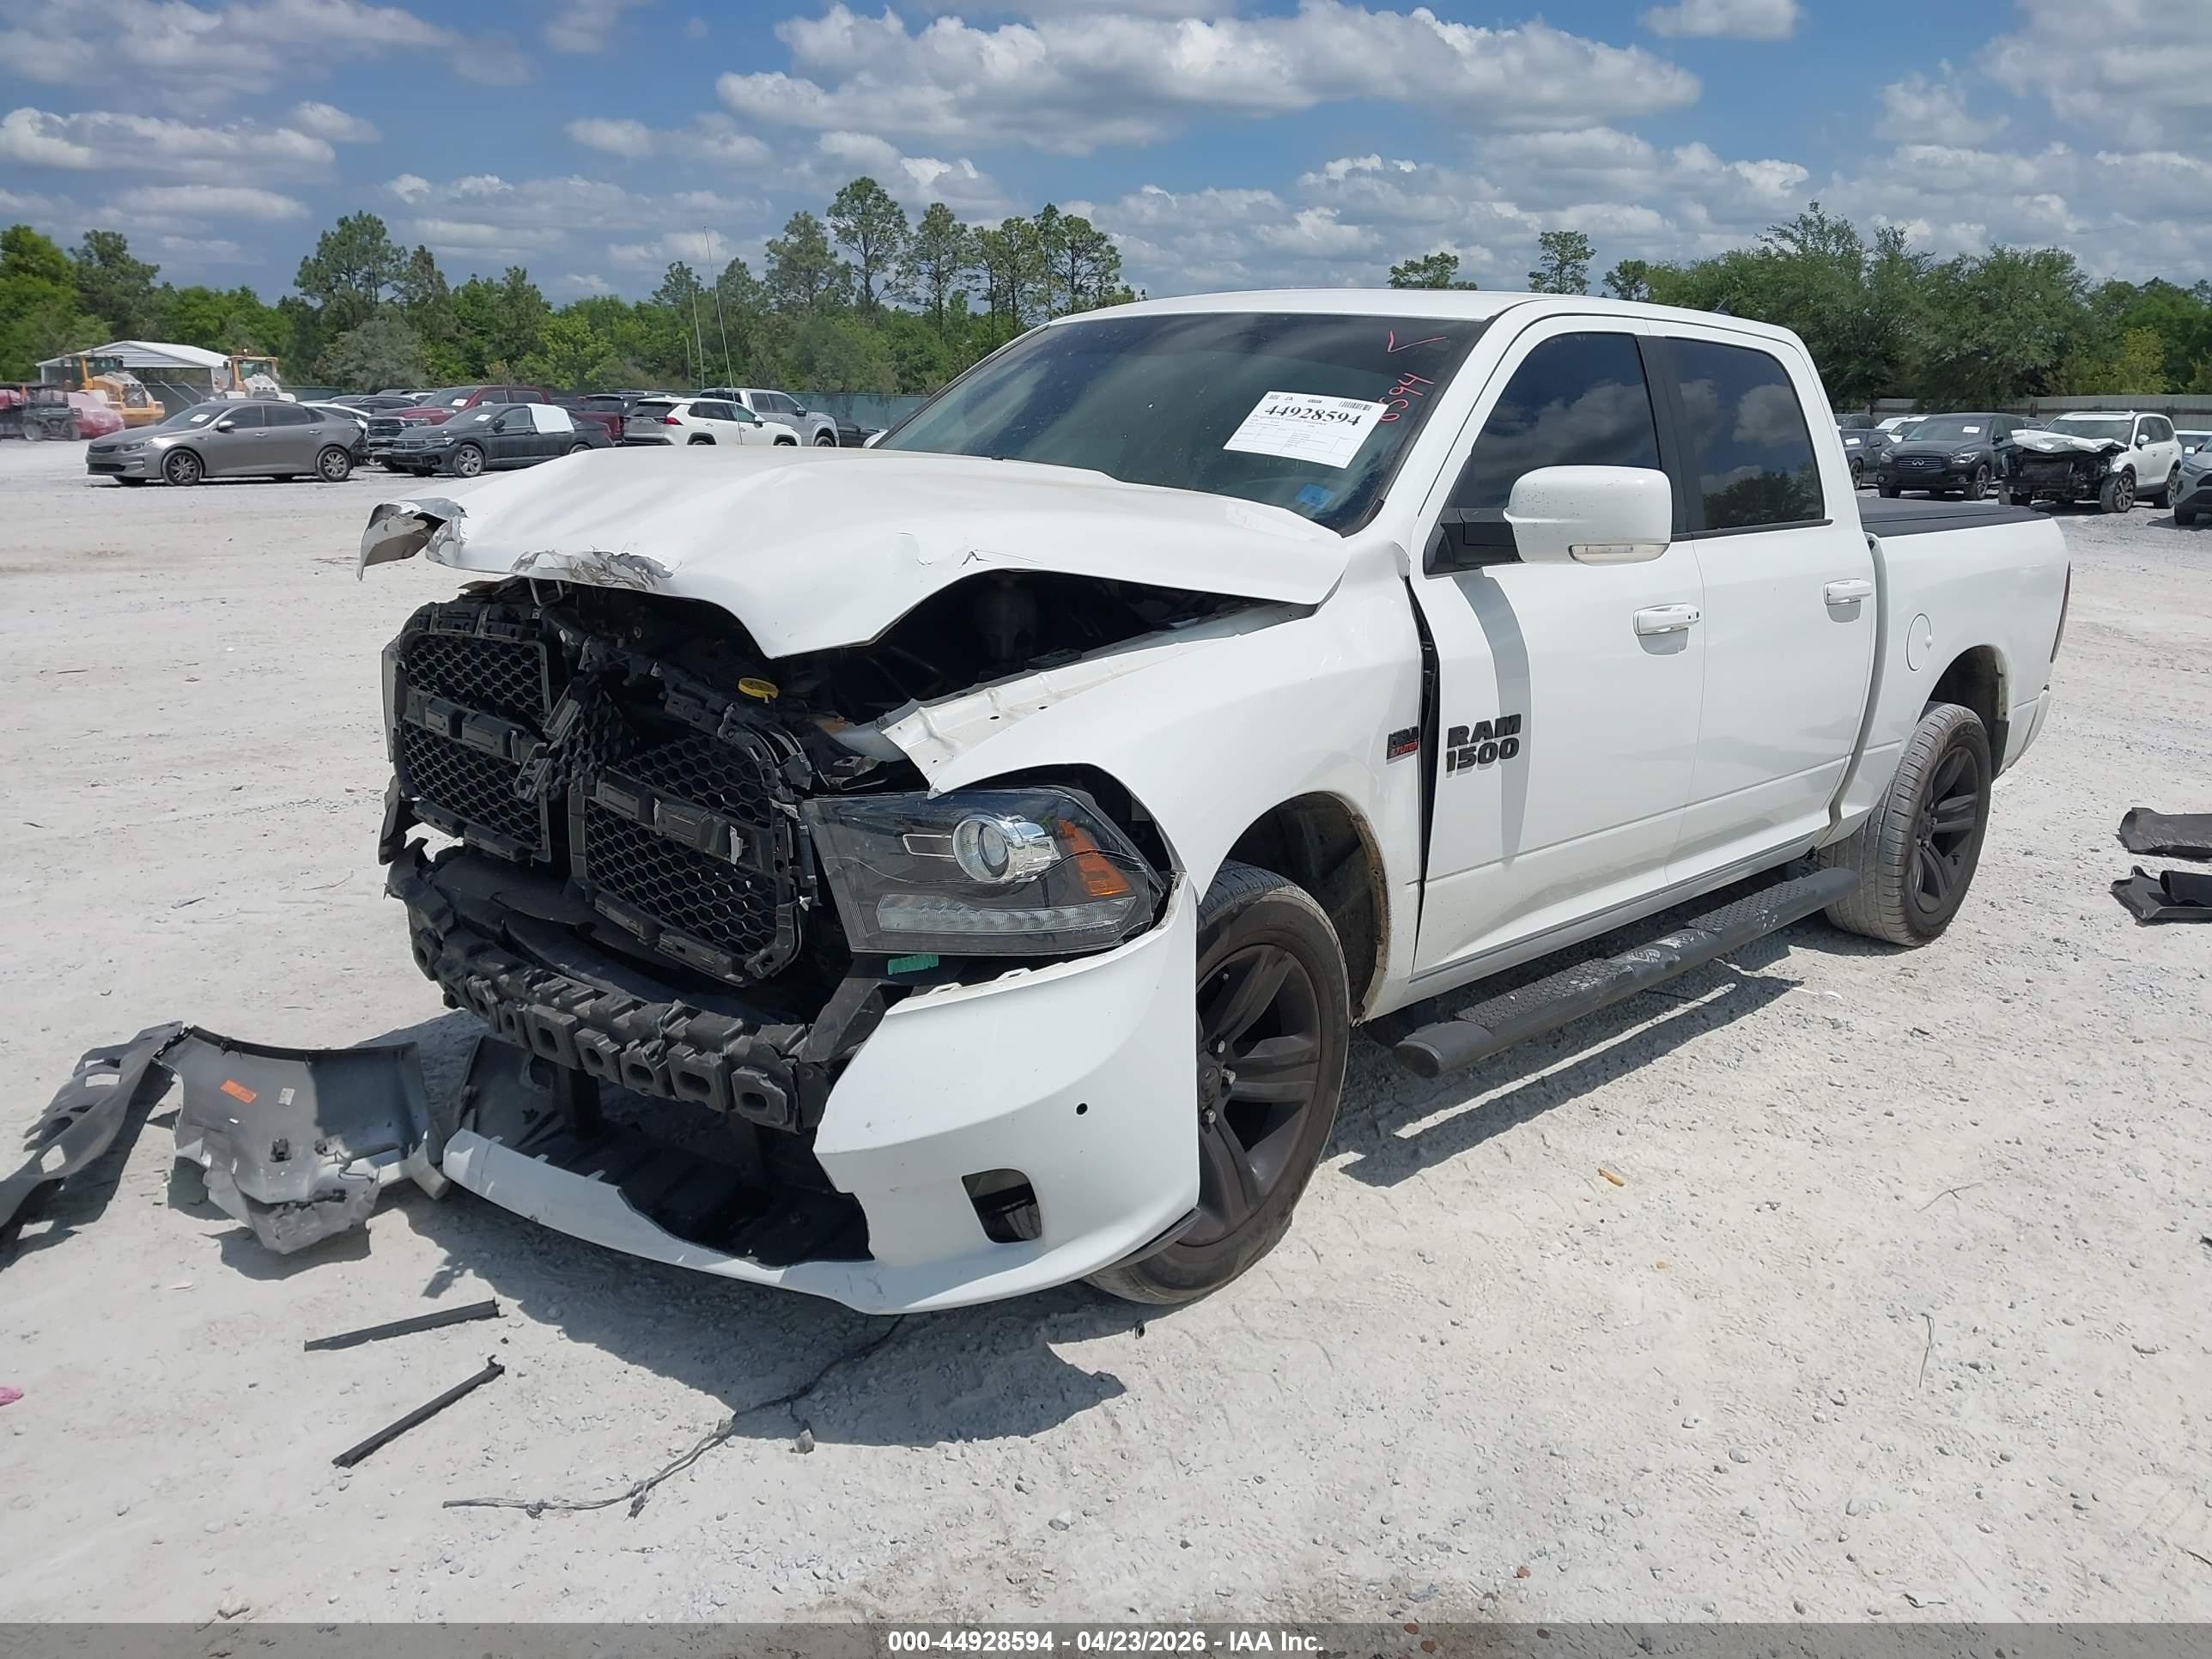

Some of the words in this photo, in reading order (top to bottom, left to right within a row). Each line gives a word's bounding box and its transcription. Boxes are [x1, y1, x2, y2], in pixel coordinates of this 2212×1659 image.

[1265, 404, 1363, 427] 44928594
[1447, 714, 1521, 749] RAM
[1446, 737, 1519, 773] 1500
